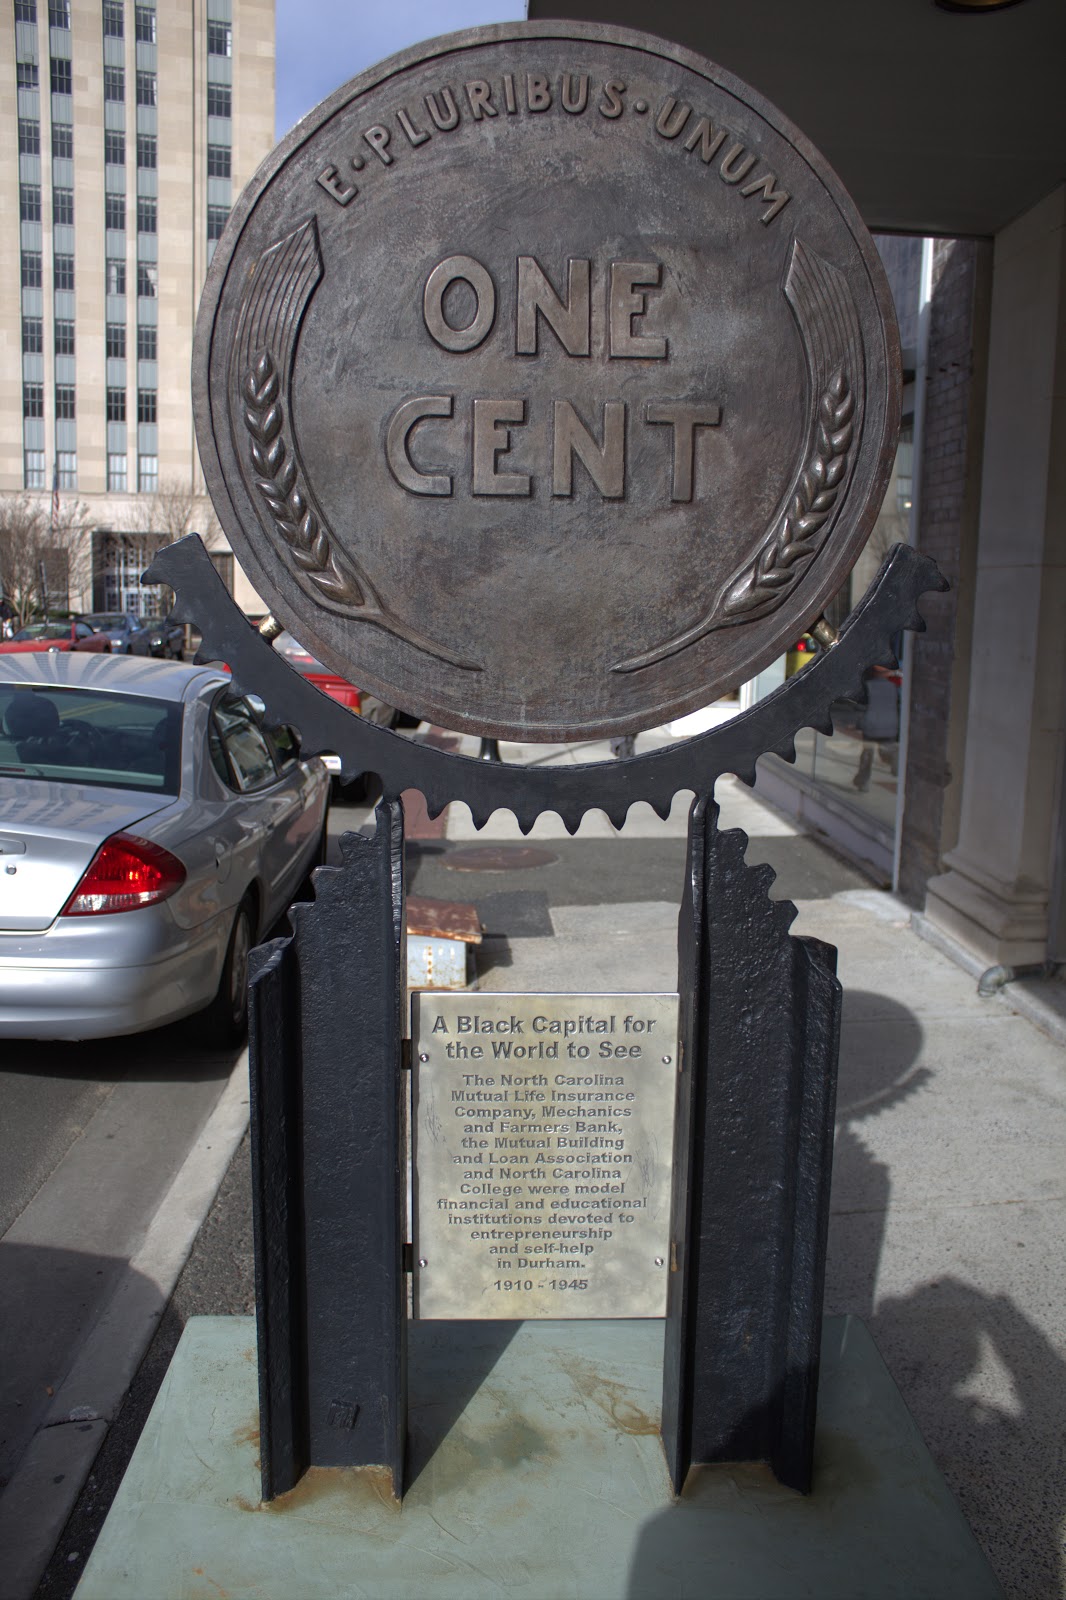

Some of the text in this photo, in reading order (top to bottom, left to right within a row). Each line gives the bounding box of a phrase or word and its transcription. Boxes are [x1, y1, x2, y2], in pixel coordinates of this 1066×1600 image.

[655, 98, 791, 226] UNUM
[422, 255, 670, 361] ONE
[384, 394, 723, 503] CENT
[432, 1015, 657, 1039] A Black Capital for
[446, 1041, 642, 1059] the World to See
[463, 1074, 624, 1086] The North Carolina
[451, 1090, 635, 1102] Mutual Life Insurance
[454, 1106, 632, 1120] Company, Mechanics
[464, 1121, 623, 1135] and Farmers Bank,
[461, 1137, 624, 1150] the Mutual Building
[453, 1152, 633, 1164] and Loan Association
[463, 1168, 621, 1179] and North Carolina
[460, 1183, 625, 1197] College were model
[437, 1198, 647, 1210] financial and educational
[448, 1213, 634, 1225] institutions devoted to
[471, 1228, 613, 1241] entrepreneurship
[489, 1243, 594, 1256] and self-help
[497, 1258, 586, 1269] in Durham.
[494, 1280, 533, 1291] 1910
[549, 1280, 588, 1291] 1945
